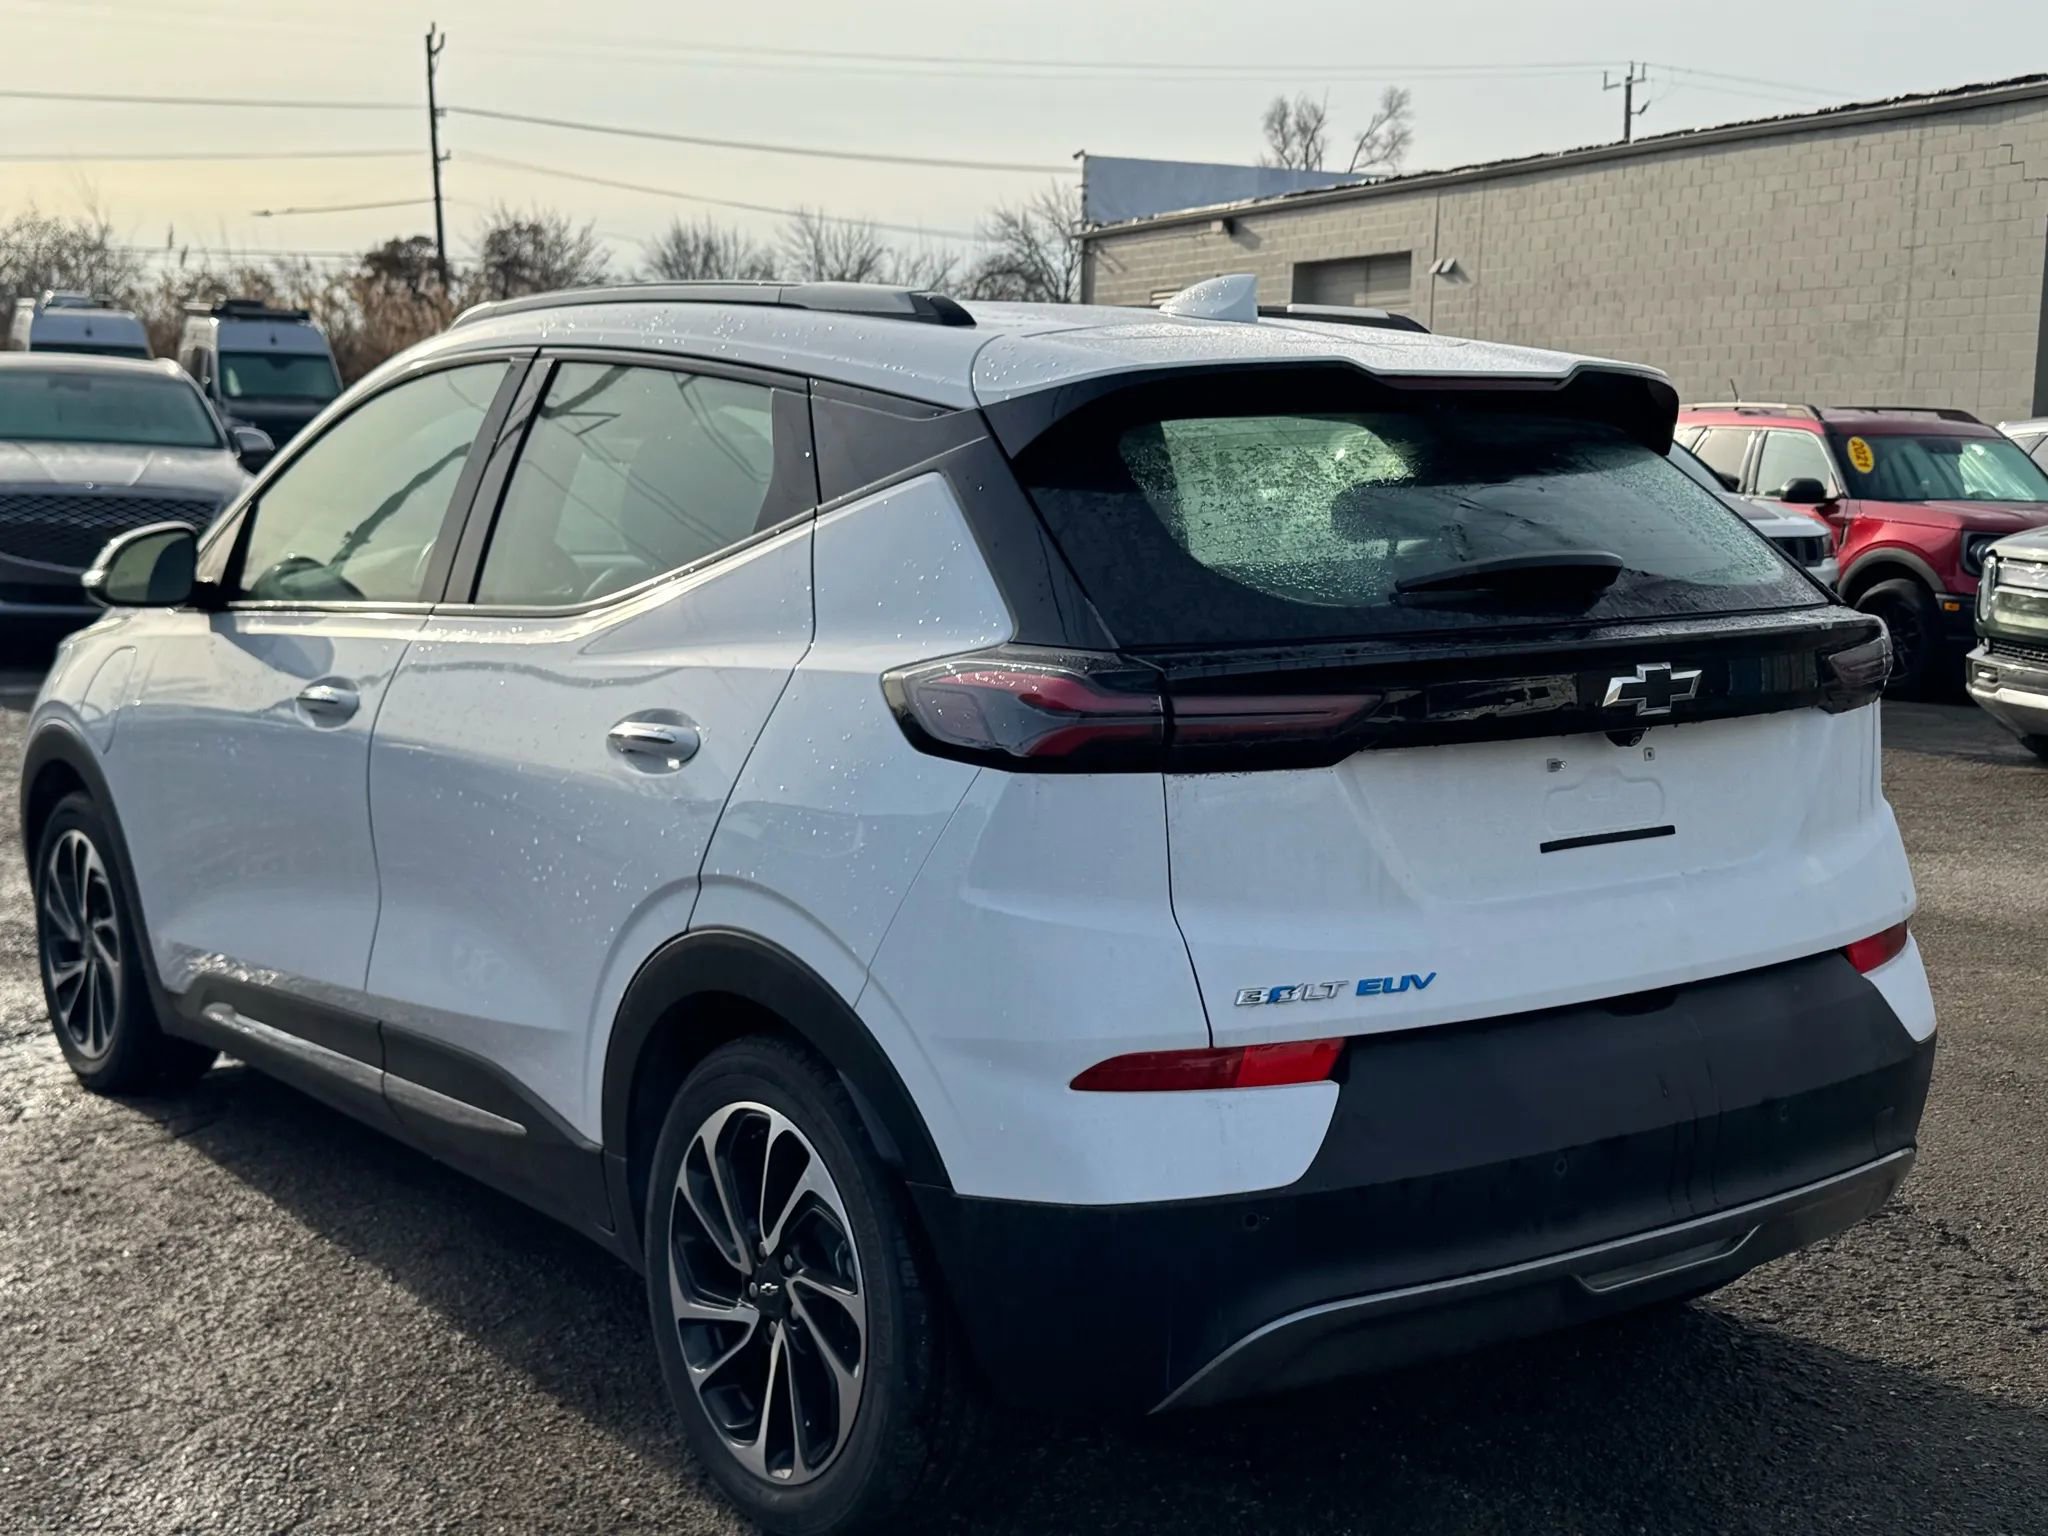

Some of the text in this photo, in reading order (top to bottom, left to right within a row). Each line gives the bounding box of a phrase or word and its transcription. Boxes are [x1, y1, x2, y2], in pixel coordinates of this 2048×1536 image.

[1851, 440, 1871, 468] 2021
[1235, 971, 1437, 1006] BOLT EUV
